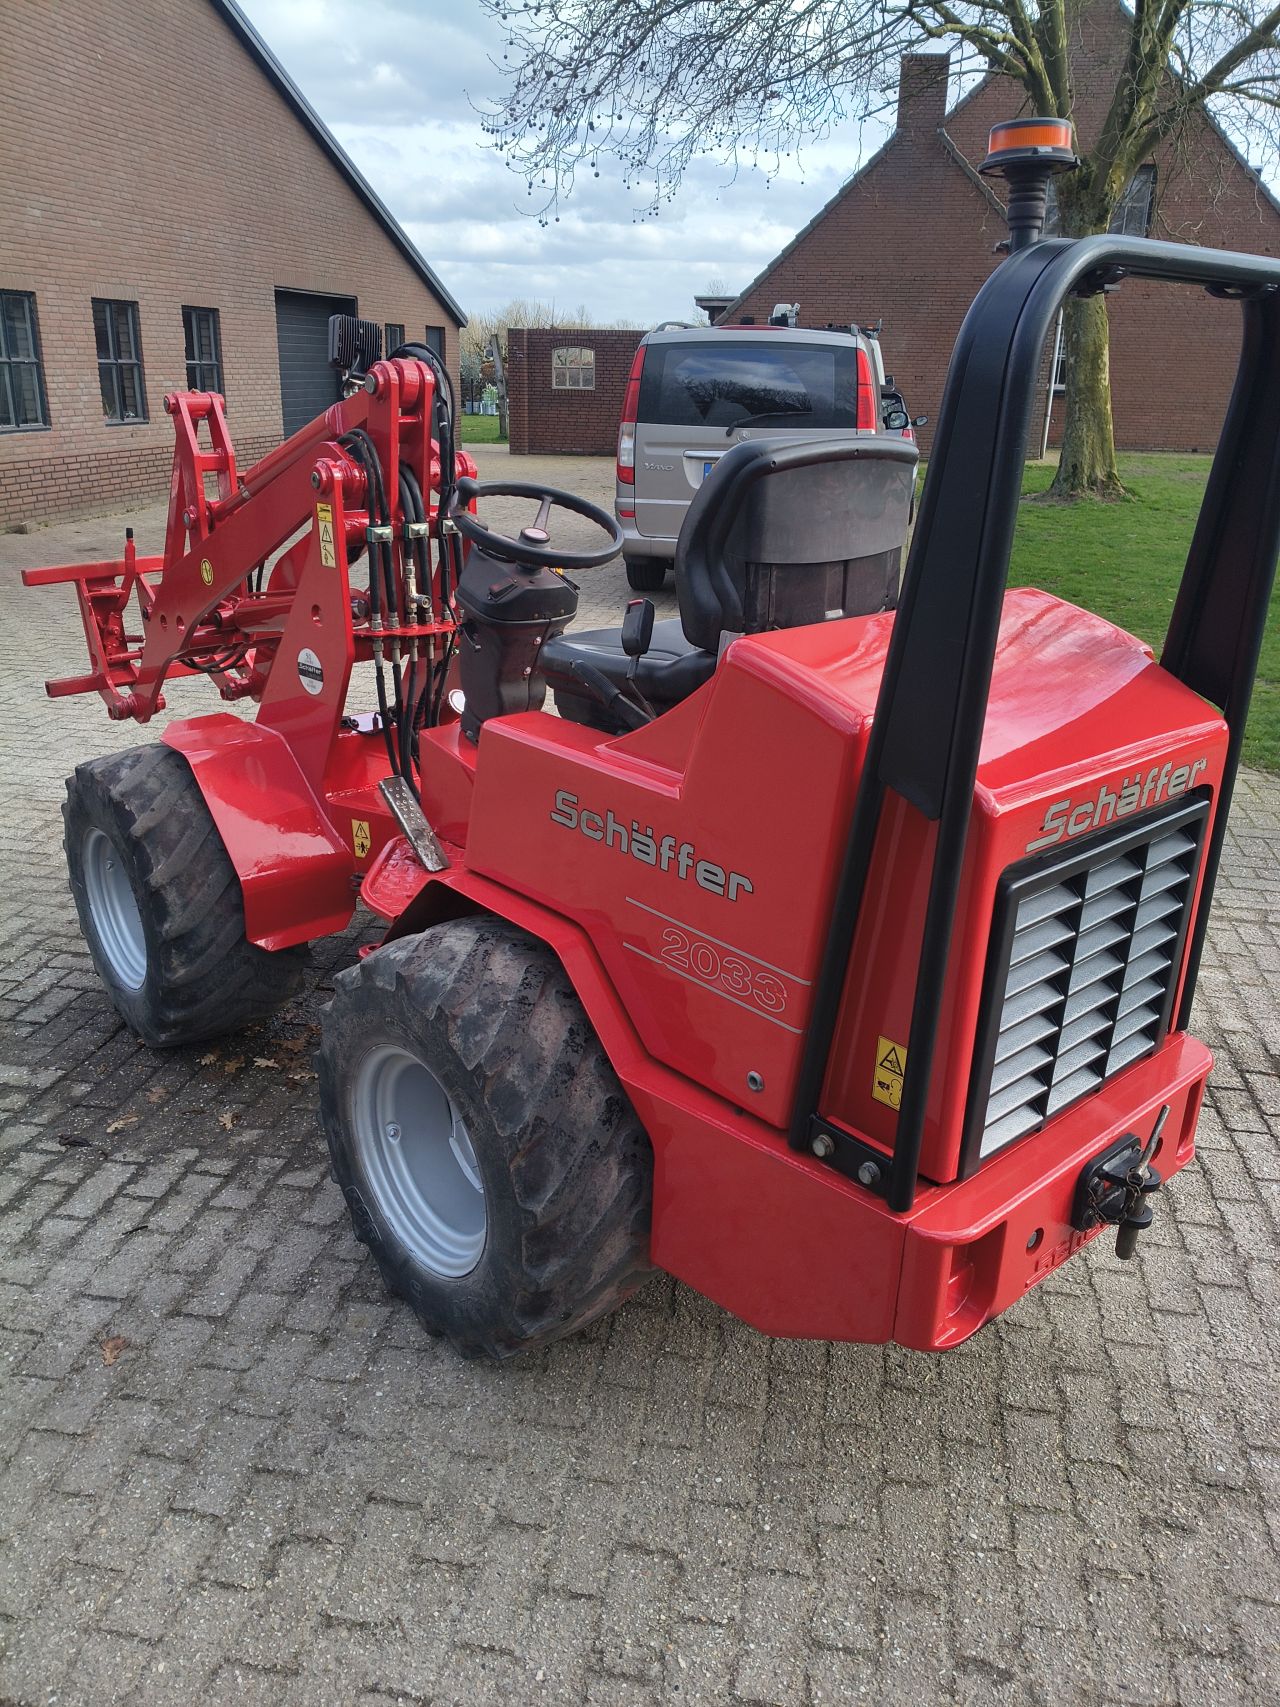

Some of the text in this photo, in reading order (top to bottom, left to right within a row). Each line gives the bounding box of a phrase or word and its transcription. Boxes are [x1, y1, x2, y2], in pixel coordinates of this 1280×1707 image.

[550, 789, 754, 901] Schäffer
[1025, 758, 1207, 854] Schäffer
[660, 928, 788, 1013] 2033
